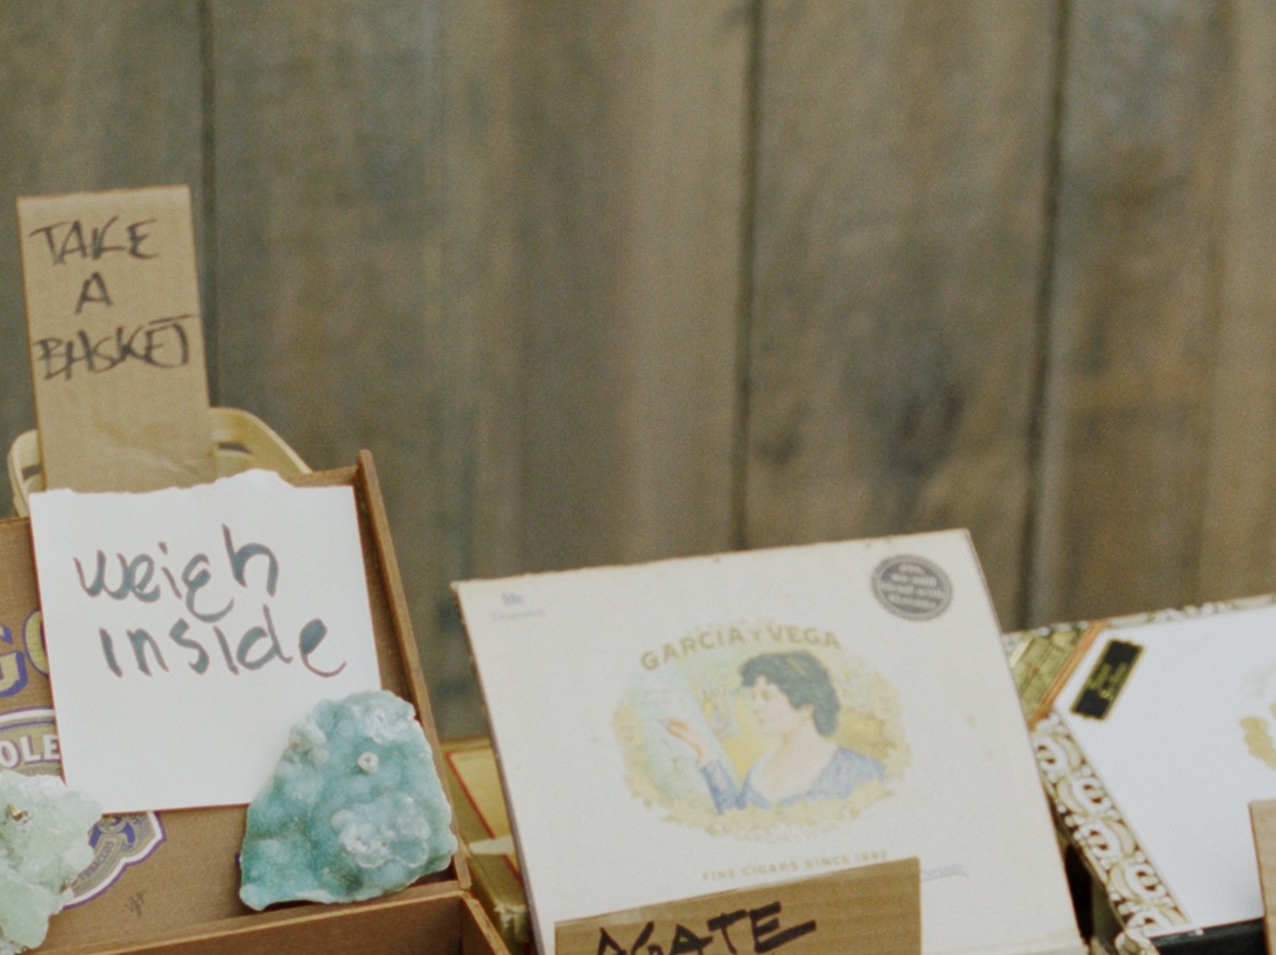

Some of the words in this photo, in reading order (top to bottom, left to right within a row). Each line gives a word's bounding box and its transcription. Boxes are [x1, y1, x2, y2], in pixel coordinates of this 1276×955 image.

[29, 216, 159, 266] TAKE
[74, 271, 113, 315] A
[34, 313, 200, 380] BASKET
[640, 627, 746, 672] GARCIA
[766, 625, 842, 650] VEGA
[701, 868, 736, 882] FINE
[741, 860, 799, 878] CIGARS
[803, 853, 853, 870] SINCE
